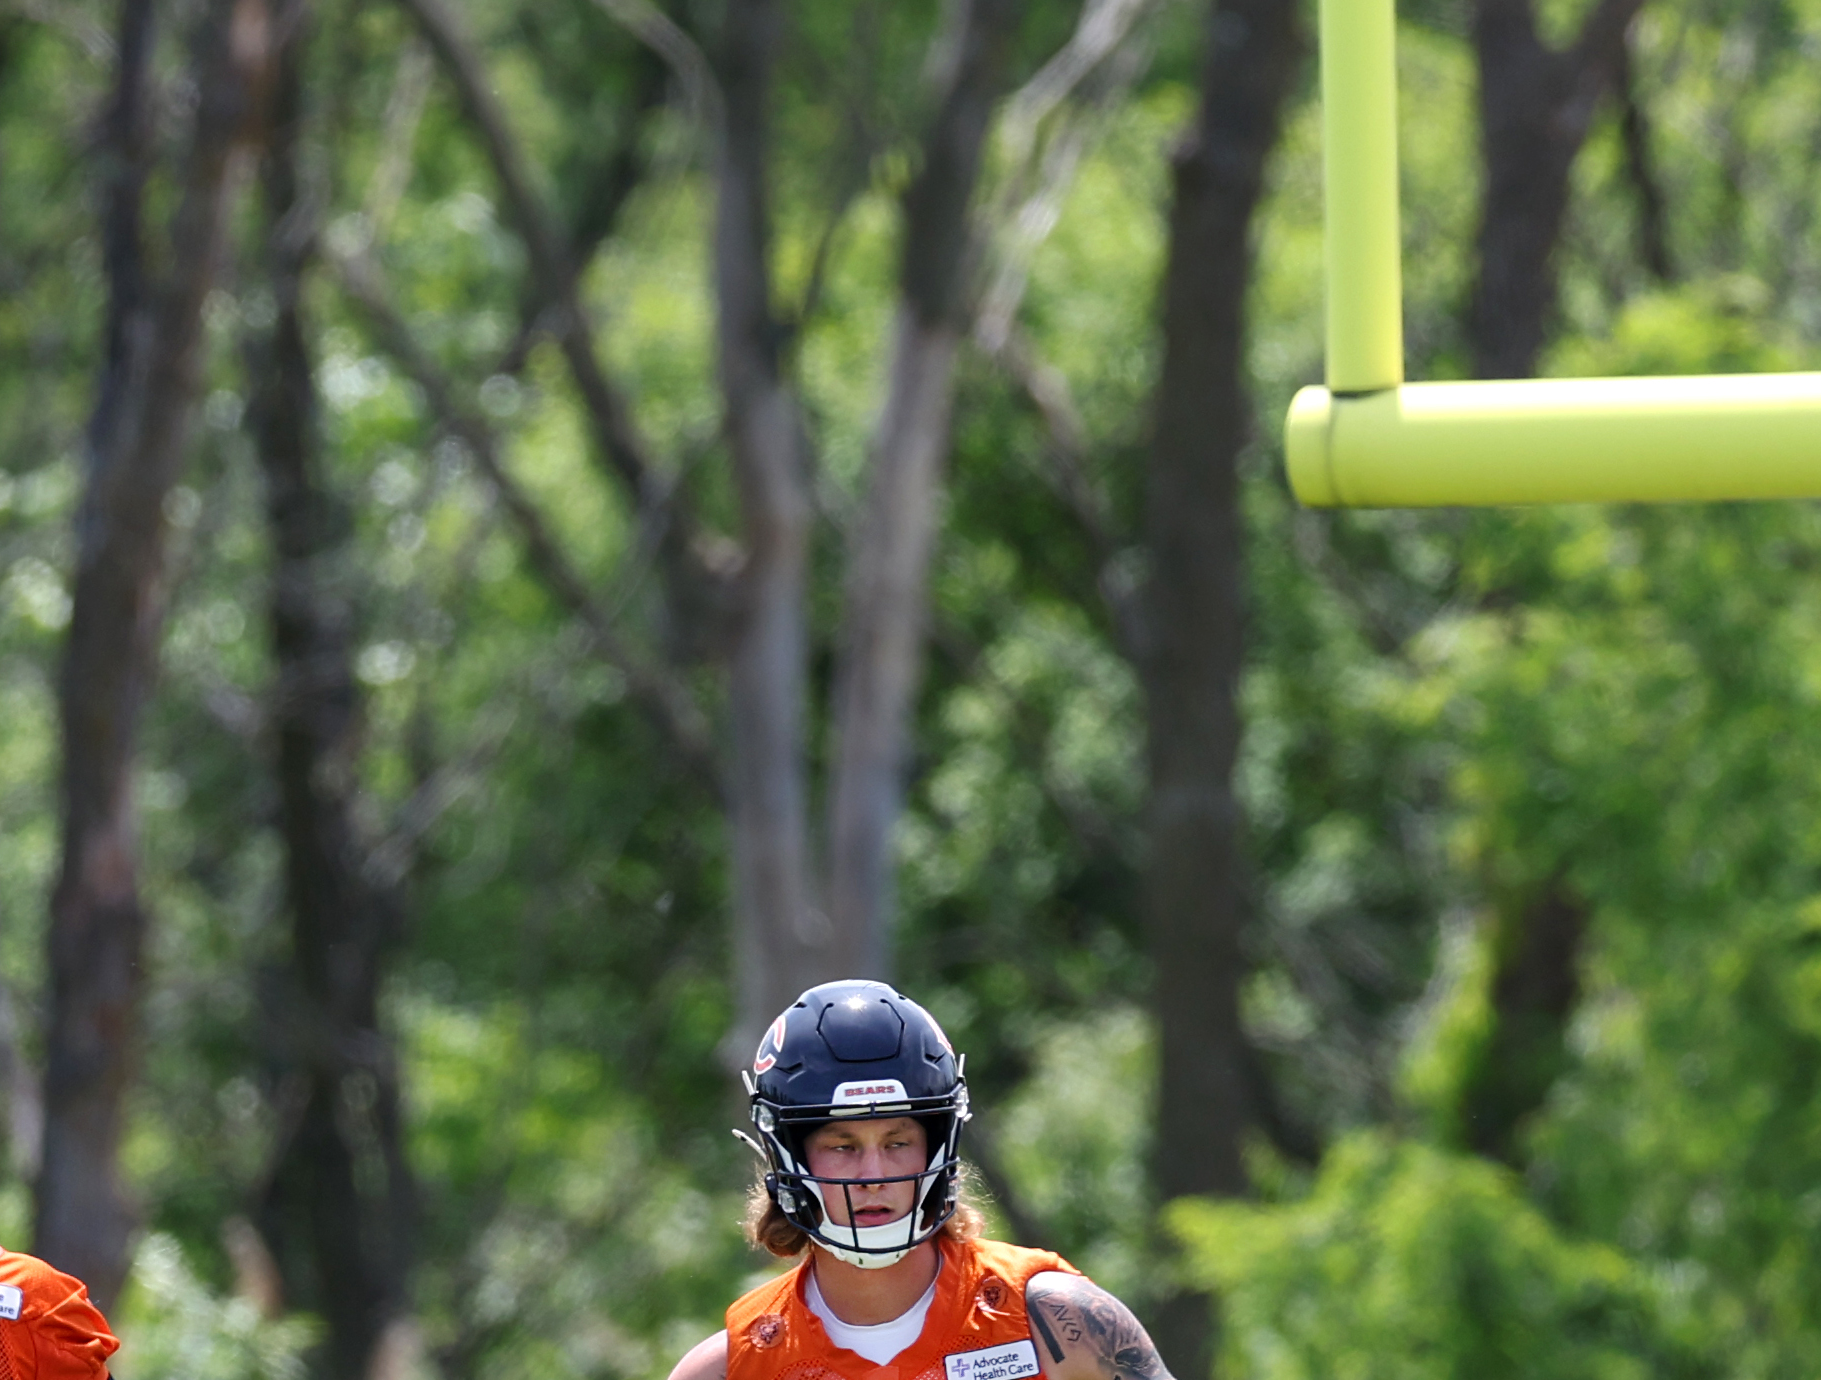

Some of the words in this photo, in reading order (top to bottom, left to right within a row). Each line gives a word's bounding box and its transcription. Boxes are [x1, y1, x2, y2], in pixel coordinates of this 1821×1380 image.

[844, 1085, 896, 1097] BEARS
[973, 1353, 1019, 1369] Advocate
[1008, 1363, 1034, 1375] Care
